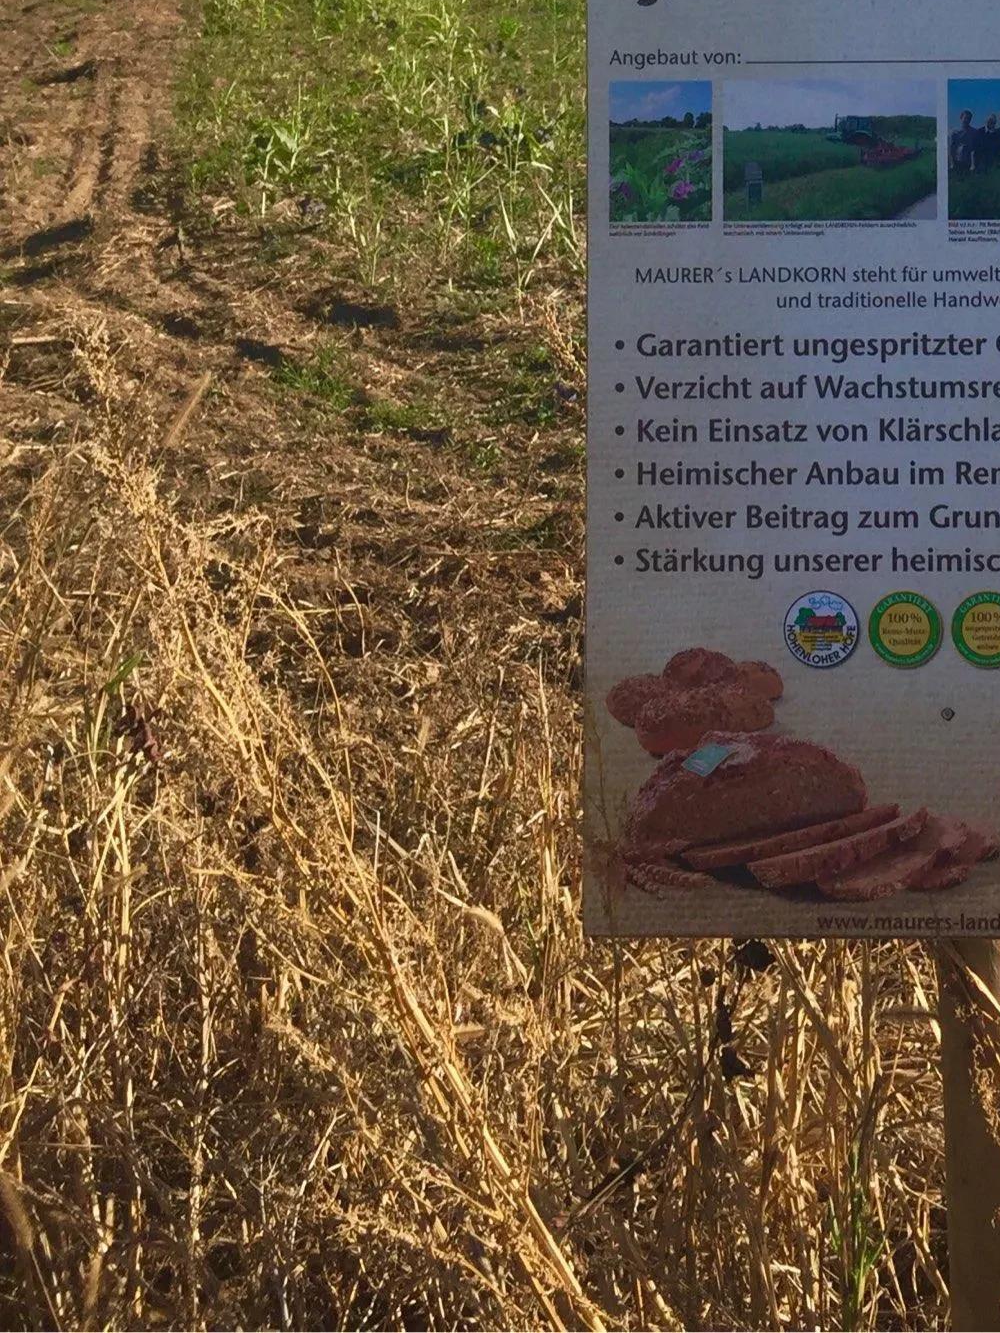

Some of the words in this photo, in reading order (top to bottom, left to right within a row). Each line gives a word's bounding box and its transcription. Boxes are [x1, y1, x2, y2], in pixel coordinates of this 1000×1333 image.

[610, 49, 698, 70] Angebaut
[703, 53, 741, 64] von:
[739, 267, 845, 283] LANDKORN
[853, 266, 897, 282] steht
[902, 266, 927, 282] für
[777, 292, 811, 308] und
[818, 292, 927, 308] traditionelle
[637, 333, 784, 356] Garantiert
[794, 332, 987, 363] ungespritzter
[635, 375, 752, 399] Verzicht
[761, 375, 807, 399] auf
[638, 418, 697, 442] Kein
[710, 418, 807, 442] Einsatz
[816, 424, 867, 442] von
[638, 461, 798, 485] Heimischer
[805, 461, 898, 485] Anbau
[910, 460, 944, 485] im
[635, 504, 737, 529] Aktiver
[747, 504, 848, 536] Beitrag
[858, 511, 918, 528] zum
[636, 547, 763, 579] Stärkung
[775, 554, 883, 572] unserer
